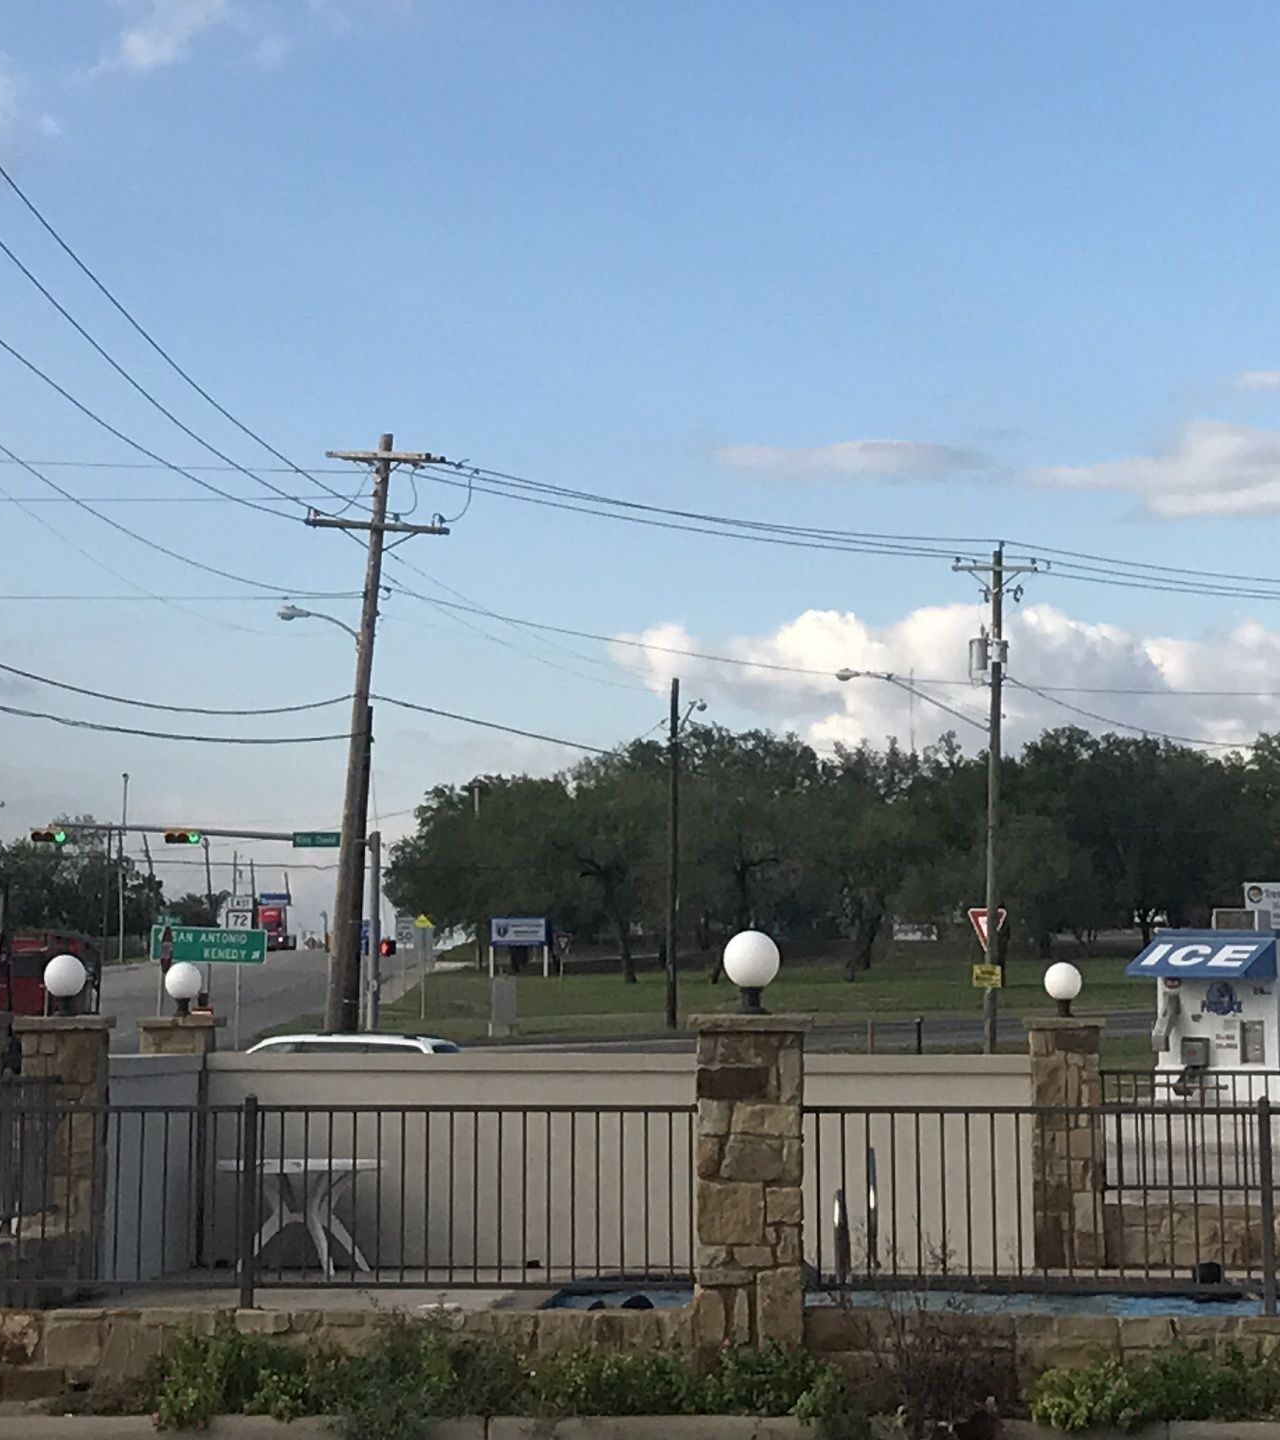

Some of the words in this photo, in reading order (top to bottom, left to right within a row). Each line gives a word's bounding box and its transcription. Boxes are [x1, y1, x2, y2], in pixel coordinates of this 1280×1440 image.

[232, 914, 248, 927] 72
[171, 931, 194, 944] SAN
[199, 932, 248, 944] ANTONIO
[1140, 944, 1259, 968] ICE
